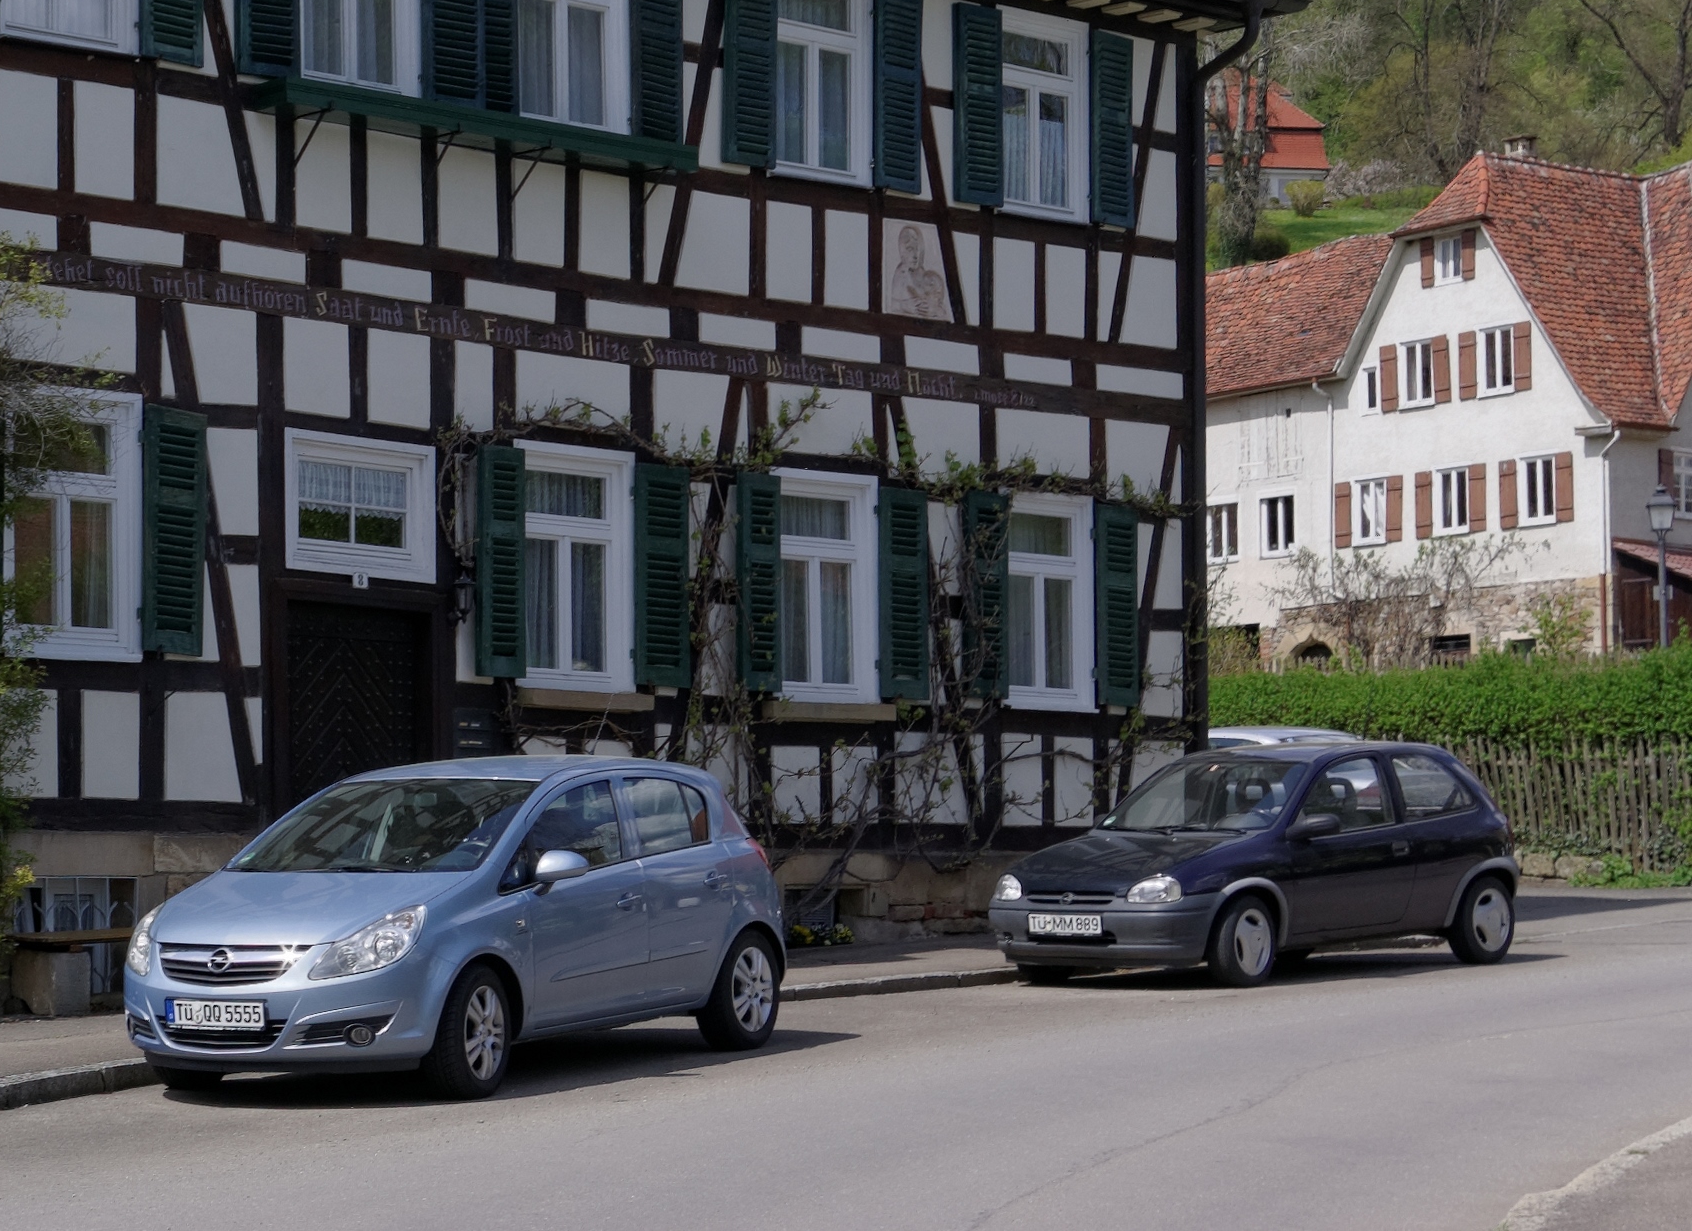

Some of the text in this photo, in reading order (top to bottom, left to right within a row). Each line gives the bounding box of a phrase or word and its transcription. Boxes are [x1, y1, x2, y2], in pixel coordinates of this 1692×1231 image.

[35, 254, 93, 283] tehet
[105, 265, 143, 293] soll
[151, 270, 209, 302] nicht
[215, 279, 308, 314] aufhören
[315, 291, 362, 322] Saat
[369, 301, 404, 327] und
[414, 306, 479, 341] Ernte,
[481, 314, 531, 348] Frost
[538, 328, 575, 352] und
[642, 338, 718, 370] Sommer
[726, 351, 759, 375] und
[832, 361, 865, 389] Tag
[869, 369, 902, 391] und
[357, 573, 364, 587] 8
[1075, 917, 1099, 932] 889
[175, 1003, 261, 1024] TÜ QQ 5555
